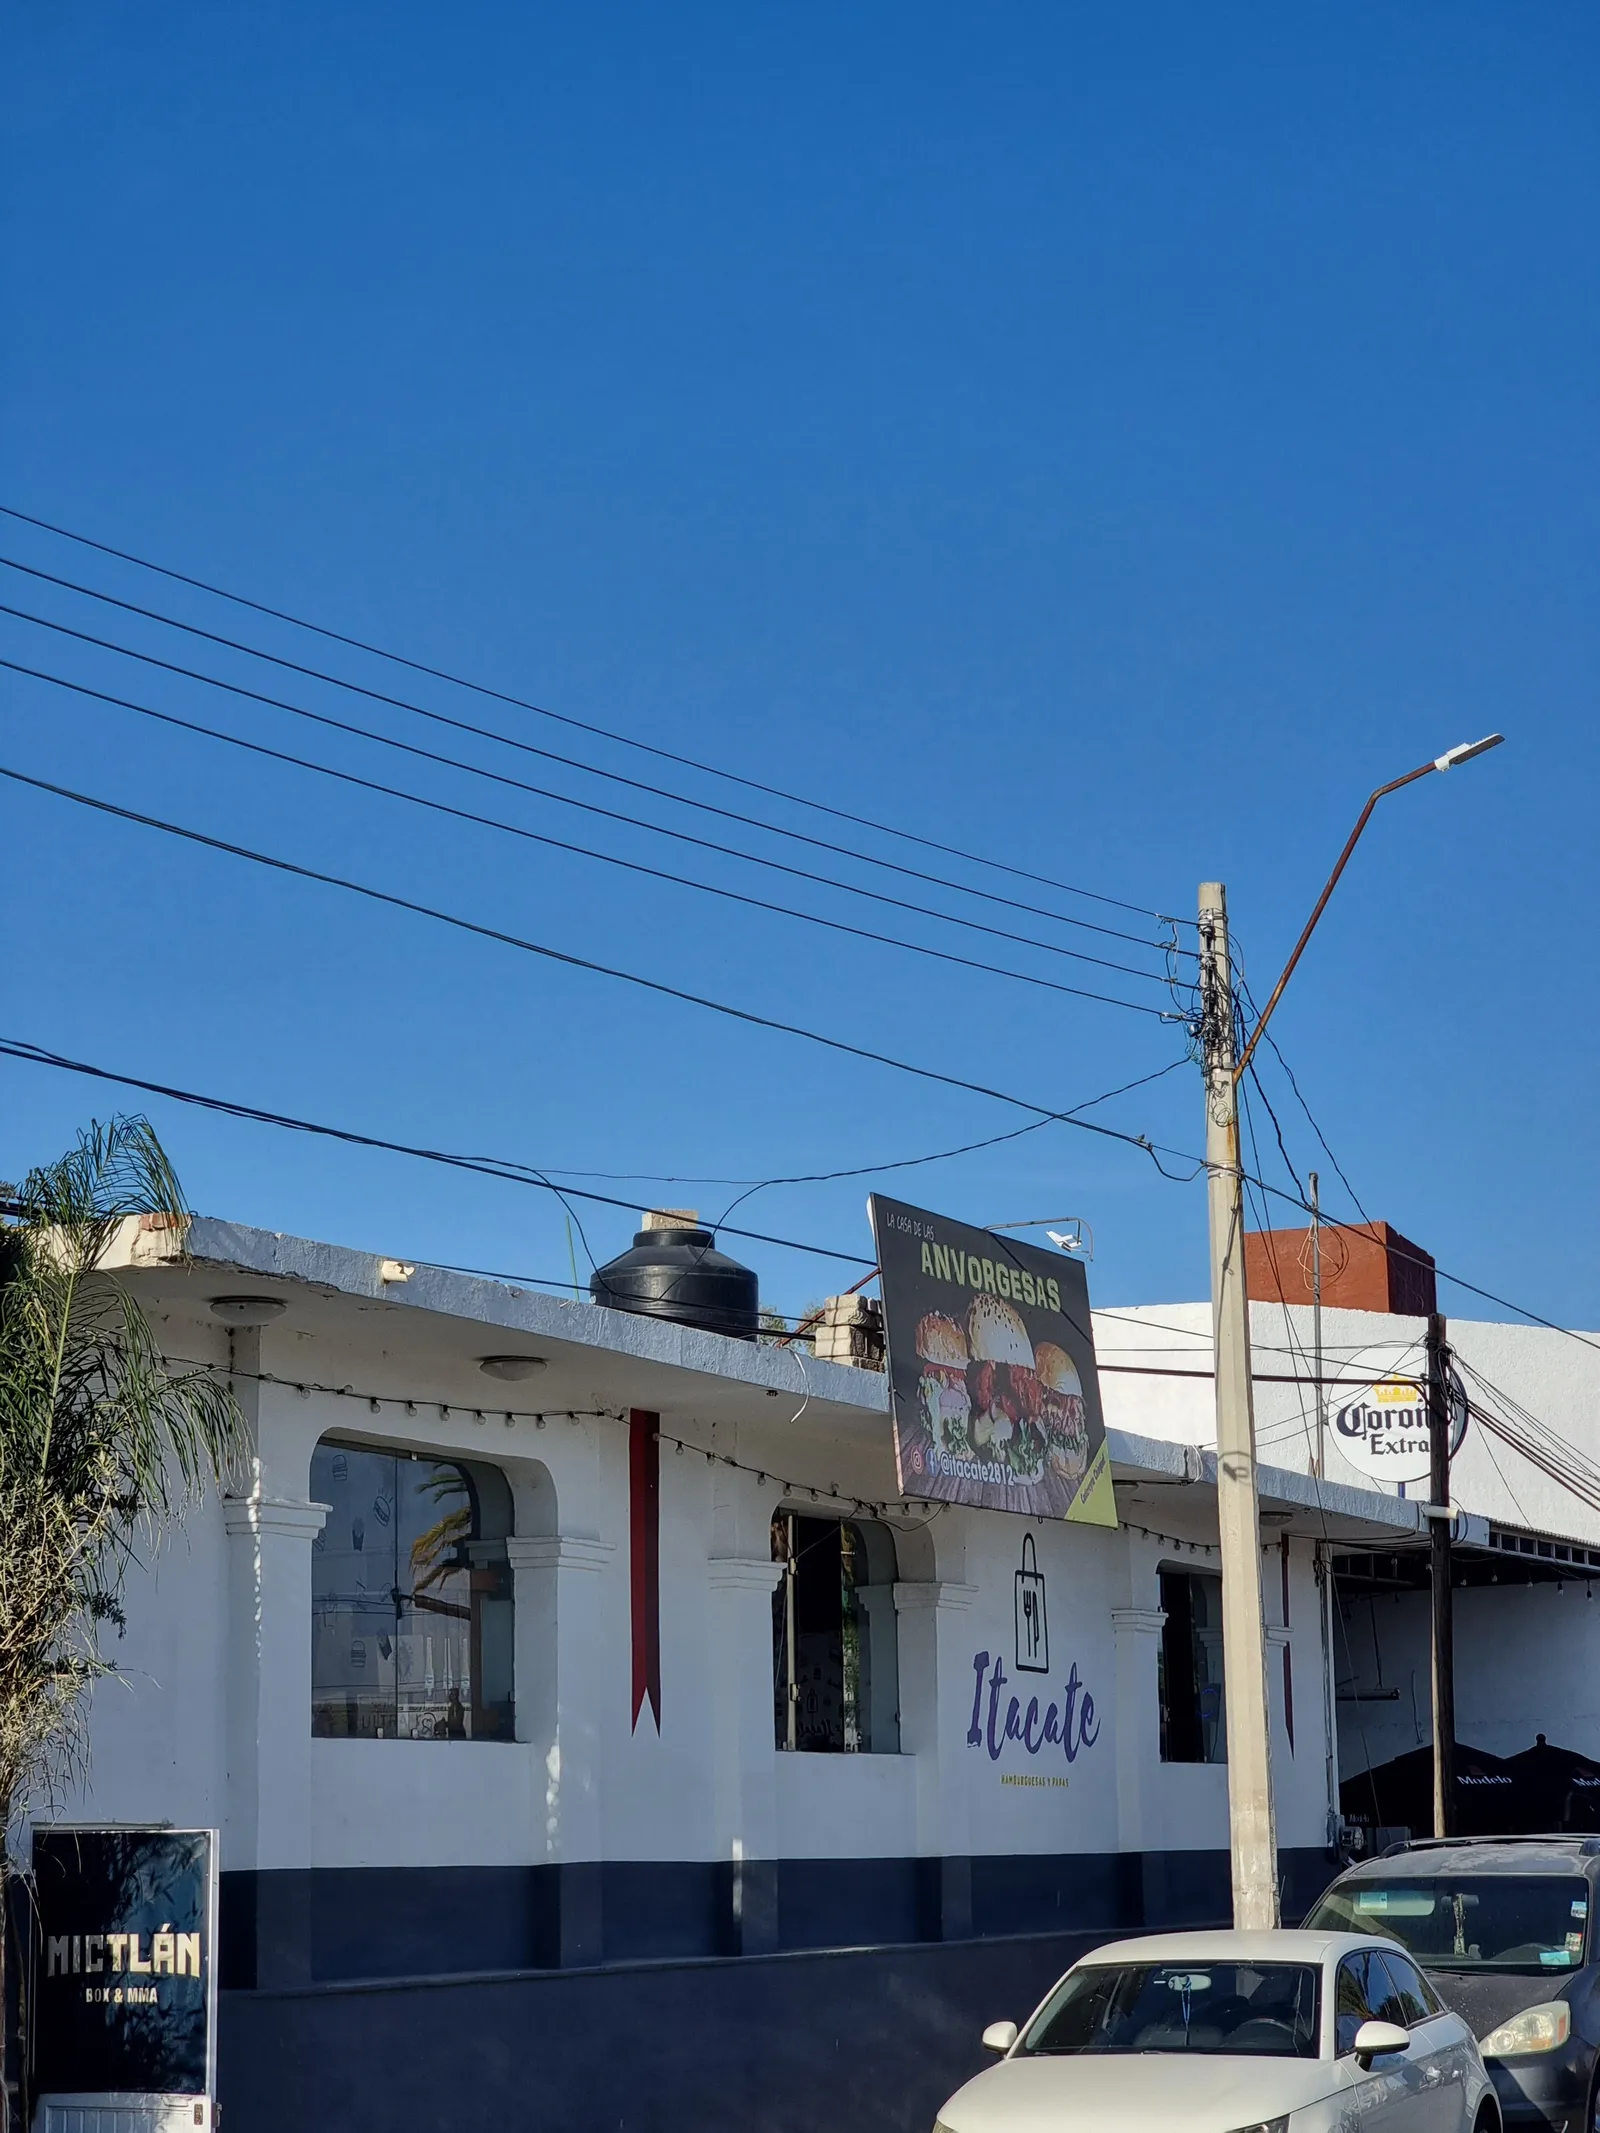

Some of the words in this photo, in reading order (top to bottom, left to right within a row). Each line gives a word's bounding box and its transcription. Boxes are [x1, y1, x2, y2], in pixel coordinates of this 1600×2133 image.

[886, 1212, 895, 1229] LA
[896, 1215, 912, 1234] CASA
[913, 1220, 922, 1238] DE
[922, 1222, 935, 1241] LAS
[921, 1240, 1061, 1313] ANVORGESAS
[1336, 1401, 1431, 1440] Coron
[1370, 1432, 1431, 1455] Extra
[941, 1452, 1016, 1487] @itacate2812
[967, 1651, 1100, 1763] Itacate
[1456, 1775, 1512, 1785] Modelo
[48, 1923, 200, 1978] MICTLÁN
[86, 1988, 109, 2003] BOX
[114, 1988, 123, 2003] &
[127, 1988, 158, 2003] MMA
